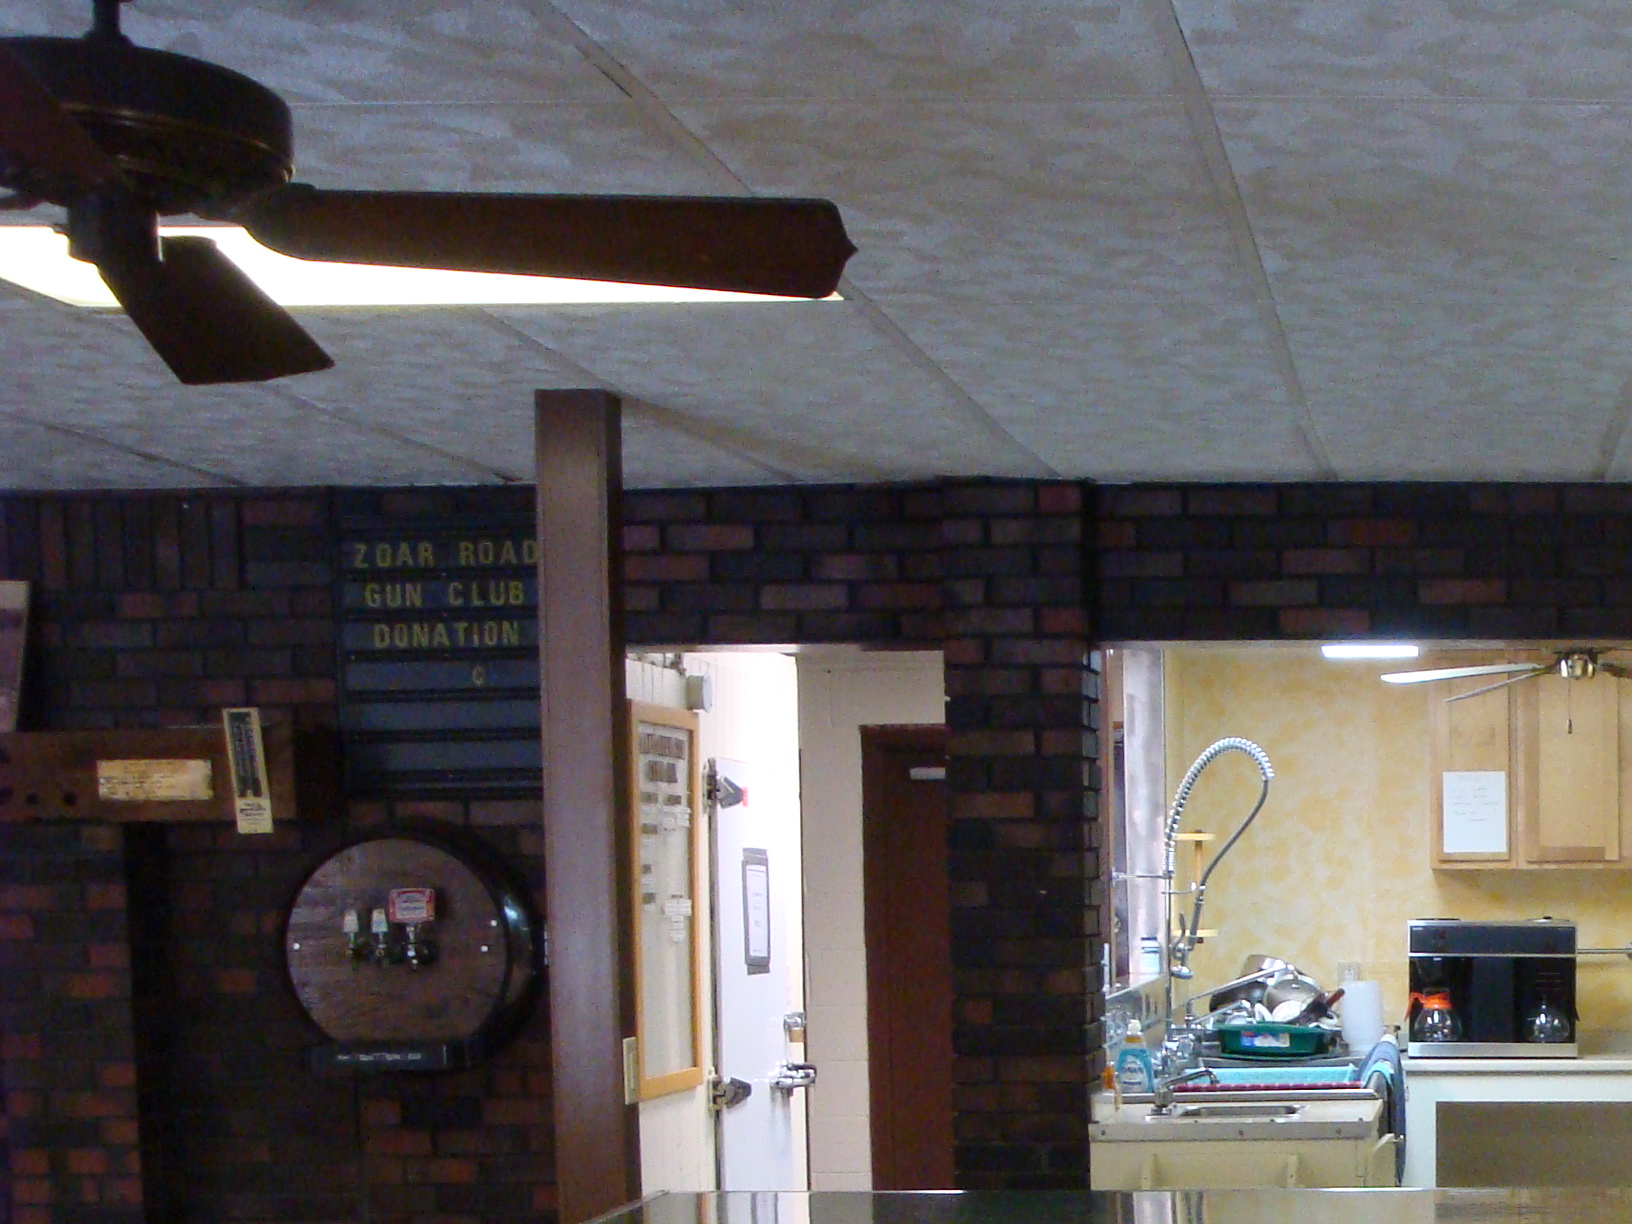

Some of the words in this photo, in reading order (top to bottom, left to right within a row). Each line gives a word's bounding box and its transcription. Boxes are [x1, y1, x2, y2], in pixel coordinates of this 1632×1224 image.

[353, 540, 434, 568] ZOAR
[459, 539, 538, 567] ROAD
[365, 582, 424, 608] GUN
[449, 580, 524, 607] CLUB
[373, 620, 520, 649] DONATION
